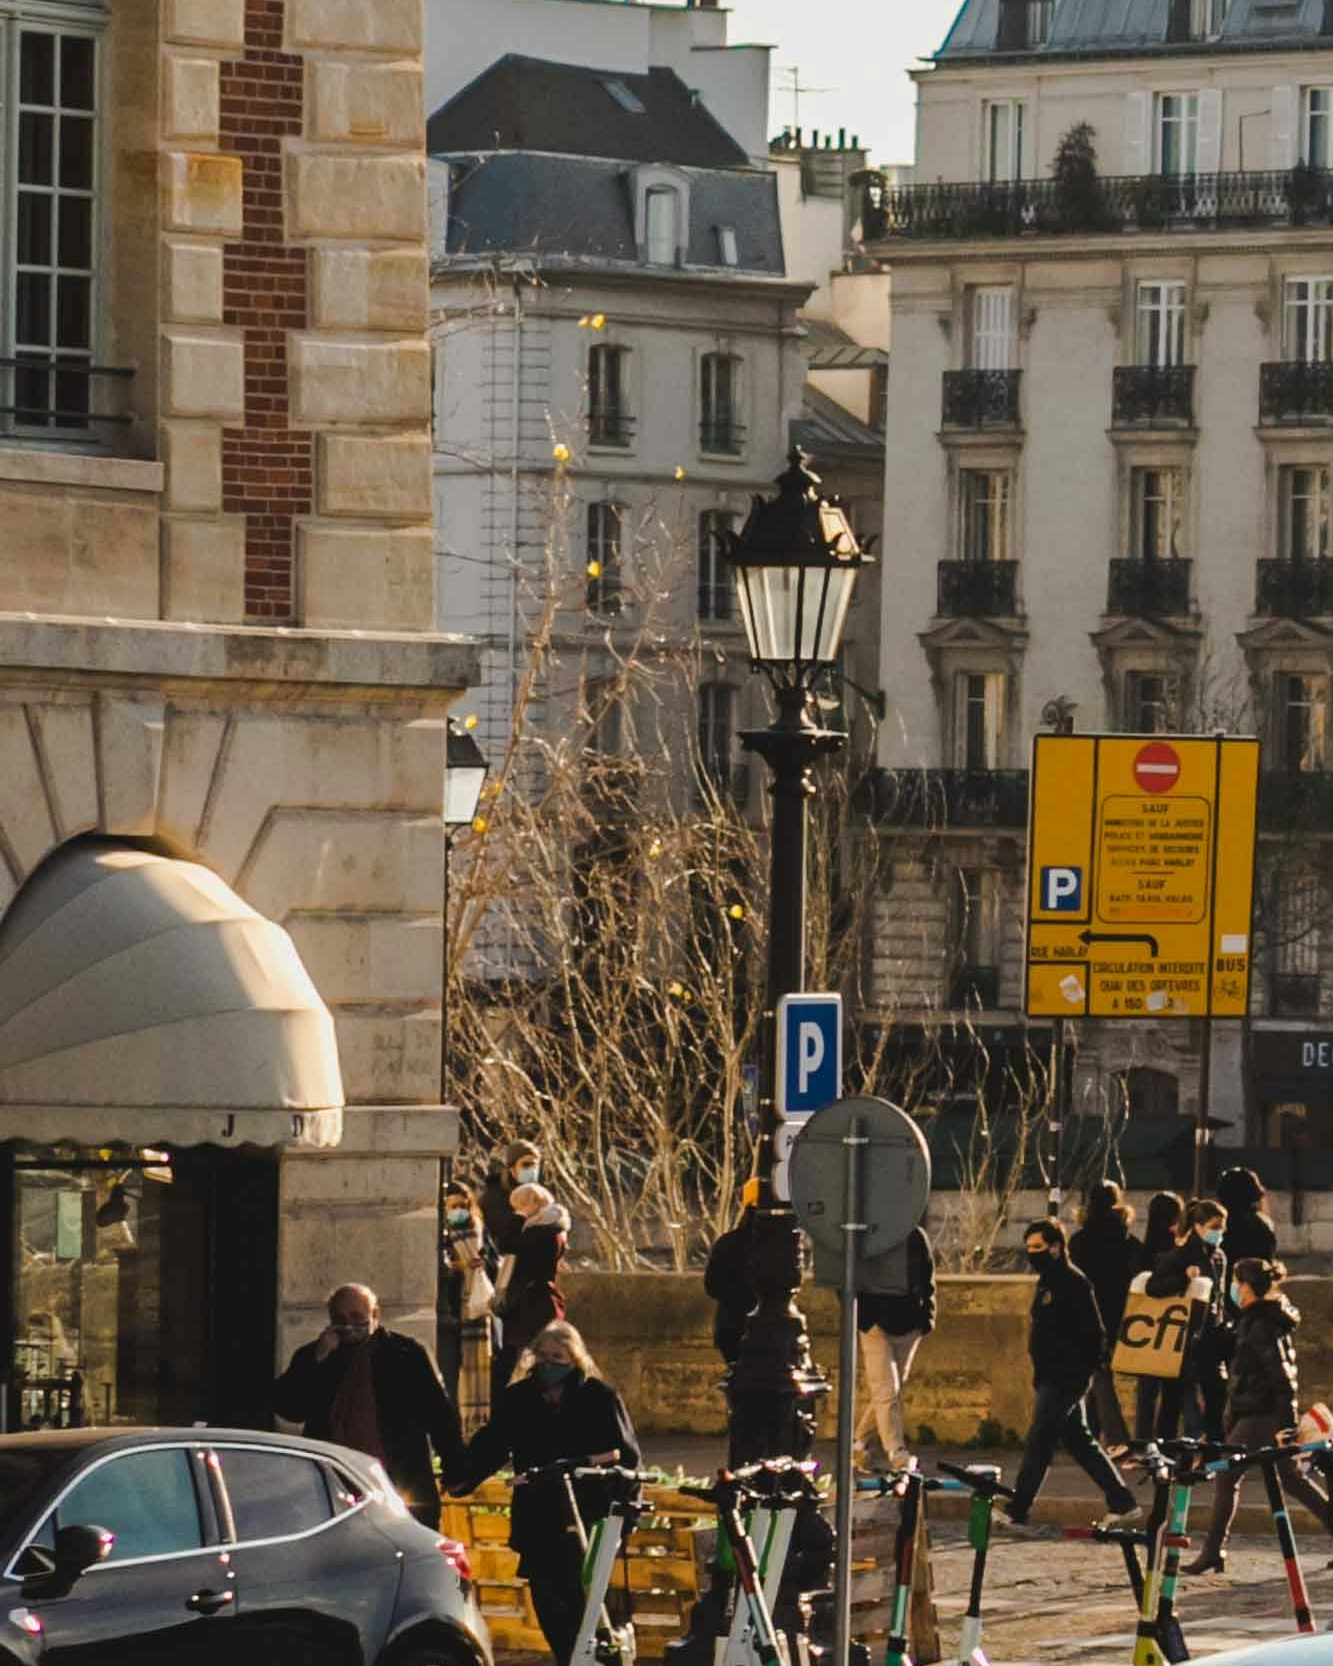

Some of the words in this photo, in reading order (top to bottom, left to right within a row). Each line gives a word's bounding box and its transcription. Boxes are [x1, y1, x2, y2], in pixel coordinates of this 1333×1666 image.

[1048, 868, 1077, 909] P
[1216, 958, 1245, 972] BUS
[1126, 979, 1145, 991] DES
[799, 1021, 825, 1093] P
